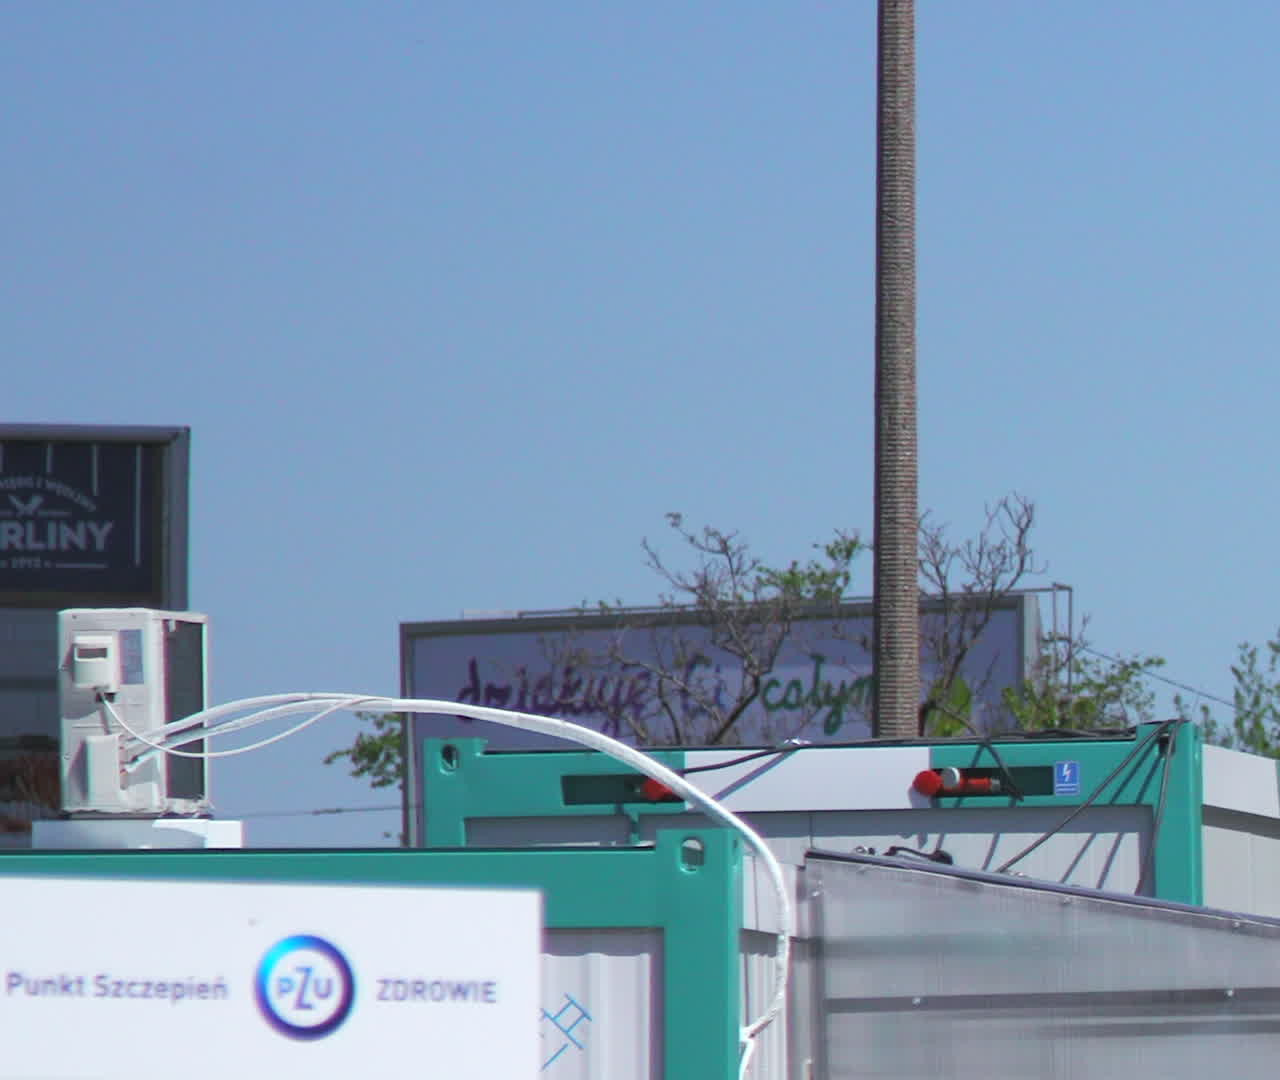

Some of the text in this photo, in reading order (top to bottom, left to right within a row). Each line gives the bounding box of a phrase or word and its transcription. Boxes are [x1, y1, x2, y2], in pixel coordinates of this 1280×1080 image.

[0, 520, 114, 550] RLINY
[5, 972, 85, 999] Punkt
[94, 972, 229, 1007] Szczepień
[376, 978, 498, 1003] ZDROWIE
